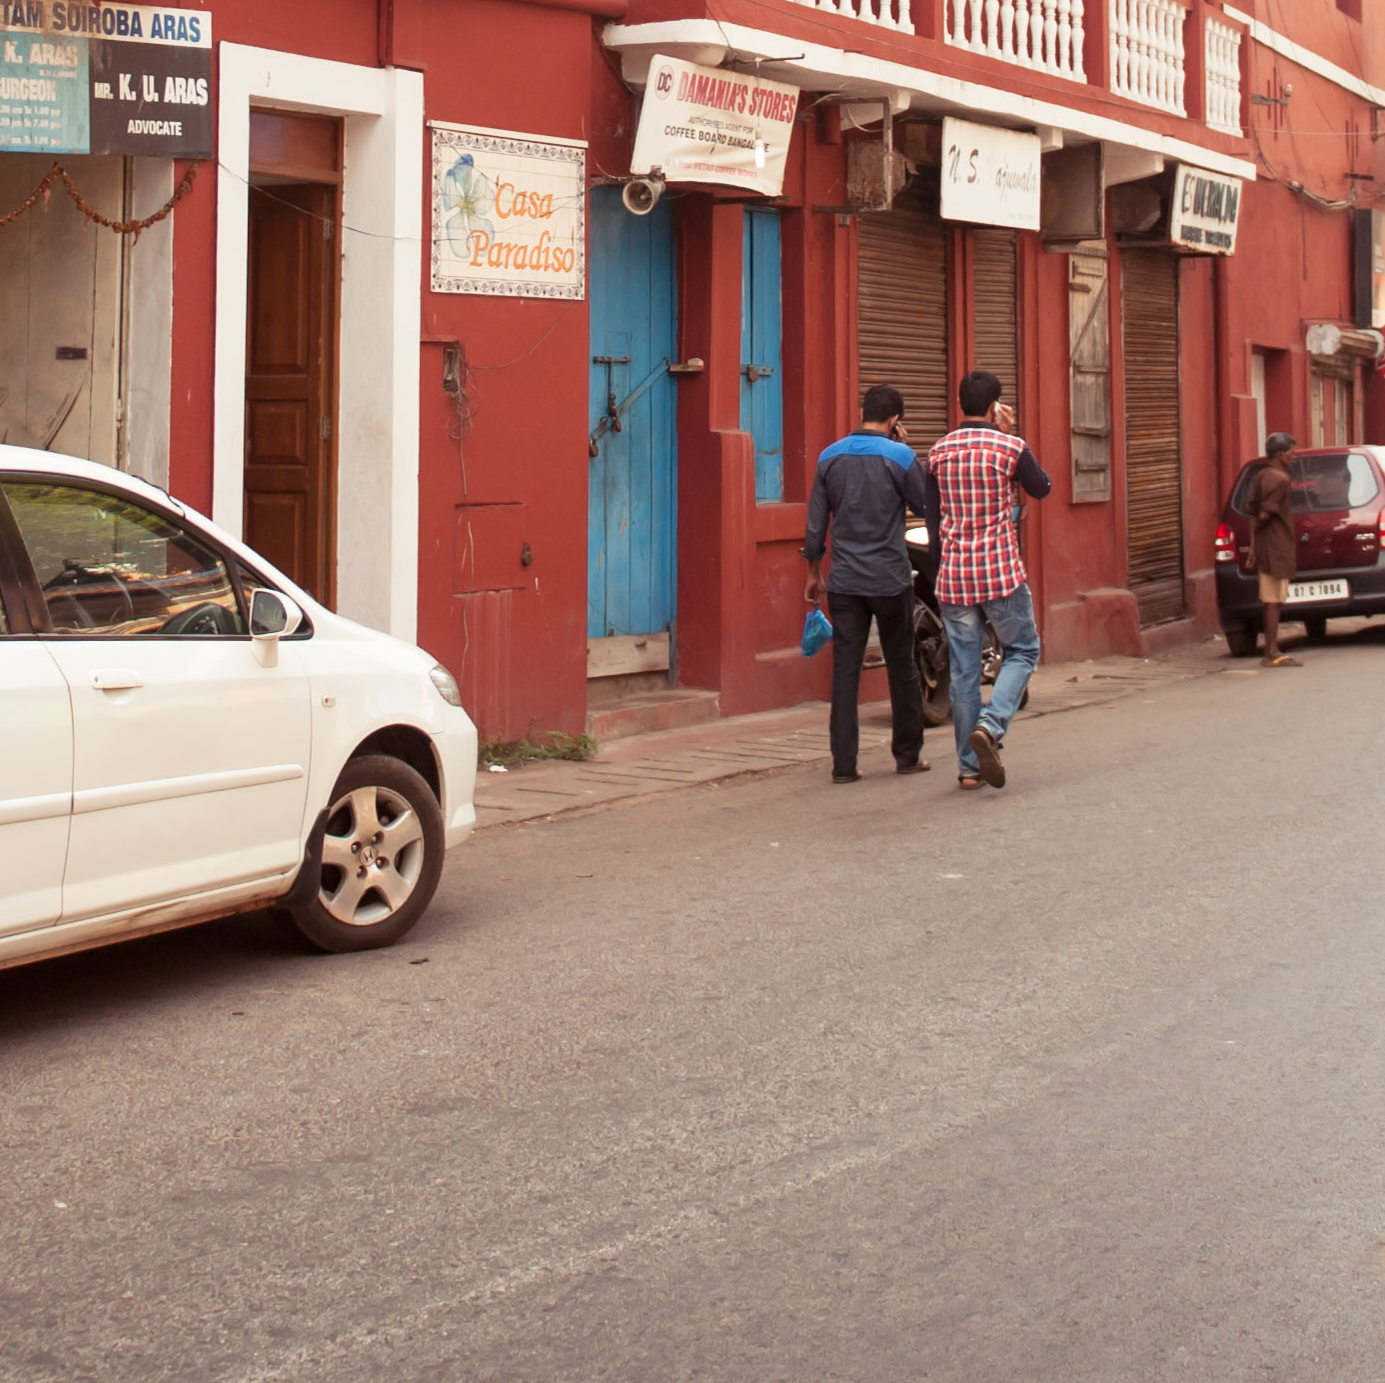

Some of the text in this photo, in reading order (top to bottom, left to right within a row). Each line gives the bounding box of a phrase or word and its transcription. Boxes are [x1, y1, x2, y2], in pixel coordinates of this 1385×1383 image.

[53, 1, 143, 38] SOIROBA
[151, 13, 201, 42] ARAS
[4, 40, 23, 64] K.
[29, 42, 78, 68] ARAS
[94, 73, 208, 106] MR. K. U. ARAS
[677, 71, 748, 114] DAMANIA'S
[749, 87, 796, 124] STORES
[127, 119, 182, 136] ADVOCATE
[664, 125, 770, 152] COFFEE BOARD BANGALE
[494, 181, 553, 220] Casa
[466, 229, 575, 274] Paradiso
